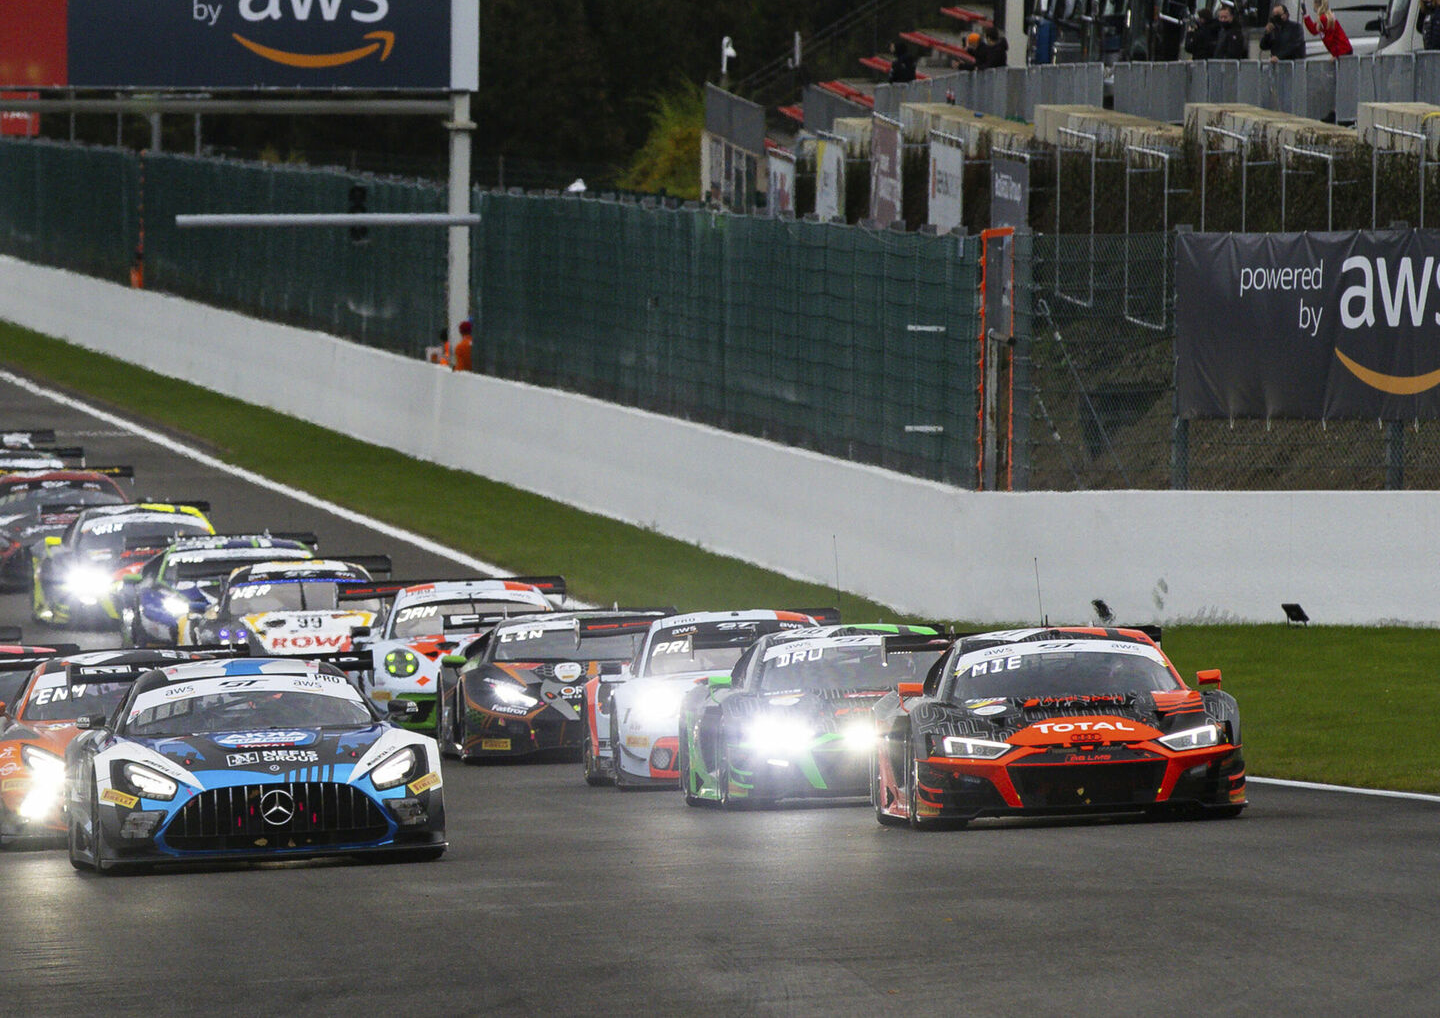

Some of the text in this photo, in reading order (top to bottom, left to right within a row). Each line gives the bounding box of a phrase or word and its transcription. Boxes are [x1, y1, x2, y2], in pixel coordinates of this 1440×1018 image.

[1239, 258, 1324, 298] powered
[1339, 255, 1440, 330] aw
[1298, 297, 1324, 337] by
[396, 605, 438, 624] JAM
[500, 629, 544, 643] LIN
[672, 625, 697, 635] aws
[271, 635, 351, 651] ROW
[1111, 641, 1141, 652] aws
[776, 647, 824, 669] DRU
[983, 646, 1013, 657] aws
[971, 654, 1023, 678] MIE
[293, 678, 322, 689] aws
[314, 674, 340, 684] PRO
[165, 685, 195, 697] aws
[491, 704, 528, 716] Fastron
[1032, 722, 1135, 734] TOTAL
